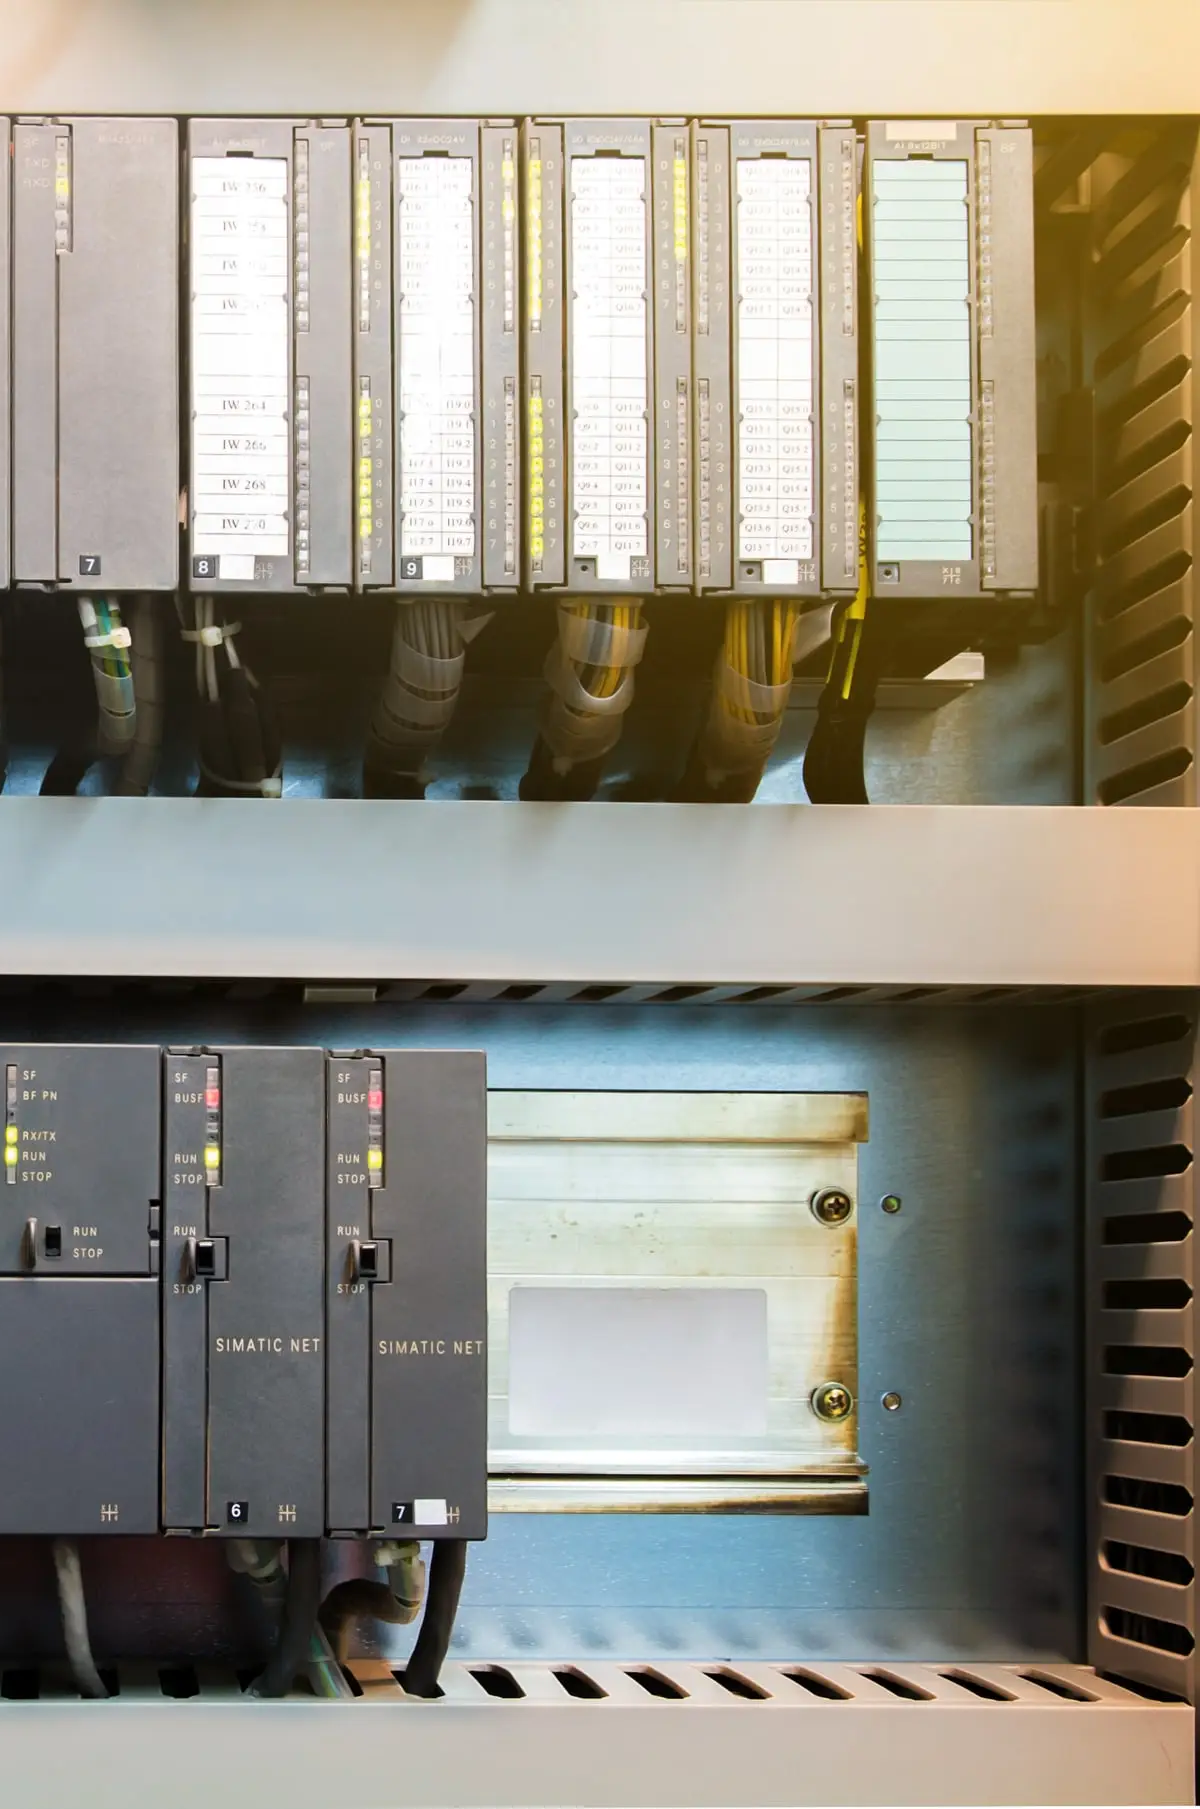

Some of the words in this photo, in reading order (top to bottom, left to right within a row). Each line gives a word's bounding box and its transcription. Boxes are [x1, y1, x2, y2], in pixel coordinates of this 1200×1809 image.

[23, 157, 50, 168] TXD
[375, 162, 381, 170] 0
[221, 180, 238, 193] IW
[375, 181, 381, 190] 1
[375, 202, 381, 211] 2
[221, 220, 238, 232] IW
[375, 221, 381, 230] 3
[221, 259, 238, 271] IW
[375, 261, 381, 270] 5
[375, 280, 381, 289] 6
[221, 298, 238, 310] IW
[375, 300, 381, 309] 7
[221, 398, 241, 412] IW
[375, 398, 382, 408] 0
[547, 398, 554, 408] 0
[375, 419, 382, 429] 1
[548, 417, 555, 428] 1
[221, 437, 241, 451] IW
[375, 438, 382, 448] 2
[548, 439, 556, 449] 2
[663, 439, 671, 449] 2
[375, 459, 382, 468] 3
[548, 458, 556, 468] 3
[221, 477, 241, 491] IW
[244, 478, 267, 491] 268
[375, 479, 382, 488] 4
[548, 478, 556, 488] 4
[375, 498, 382, 508] 5
[548, 498, 555, 509] 5
[663, 499, 671, 509] 5
[221, 517, 241, 531] IW
[375, 519, 382, 528] 6
[548, 518, 556, 529] 6
[375, 538, 382, 548] 7
[548, 538, 556, 549] 7
[663, 539, 671, 549] 7
[84, 558, 96, 573] 7
[197, 560, 209, 574] 8
[406, 561, 418, 576] 9
[23, 1070, 36, 1081] SF
[174, 1072, 188, 1083] SF
[337, 1072, 351, 1083] SF
[23, 1091, 37, 1101] BF
[43, 1091, 58, 1101] PN
[174, 1093, 203, 1103] BUSF
[337, 1093, 366, 1103] BUSF
[22, 1131, 57, 1141] RX/TX
[22, 1151, 46, 1161] RUN
[174, 1154, 197, 1164] RUN
[337, 1154, 360, 1164] RUN
[21, 1172, 52, 1182] STOP
[174, 1174, 203, 1184] STOP
[337, 1174, 366, 1184] STOP
[73, 1227, 97, 1237] RUN
[174, 1226, 196, 1236] RUN
[336, 1226, 359, 1236] RUN
[72, 1248, 103, 1258] STOP
[173, 1283, 202, 1294] STOP
[336, 1283, 365, 1294] STOP
[216, 1338, 283, 1353] SIMATIC
[290, 1338, 321, 1353] NET
[378, 1340, 446, 1355] SIMATIC
[454, 1340, 483, 1355] NET
[230, 1503, 241, 1518] 6
[396, 1505, 406, 1520] 7
